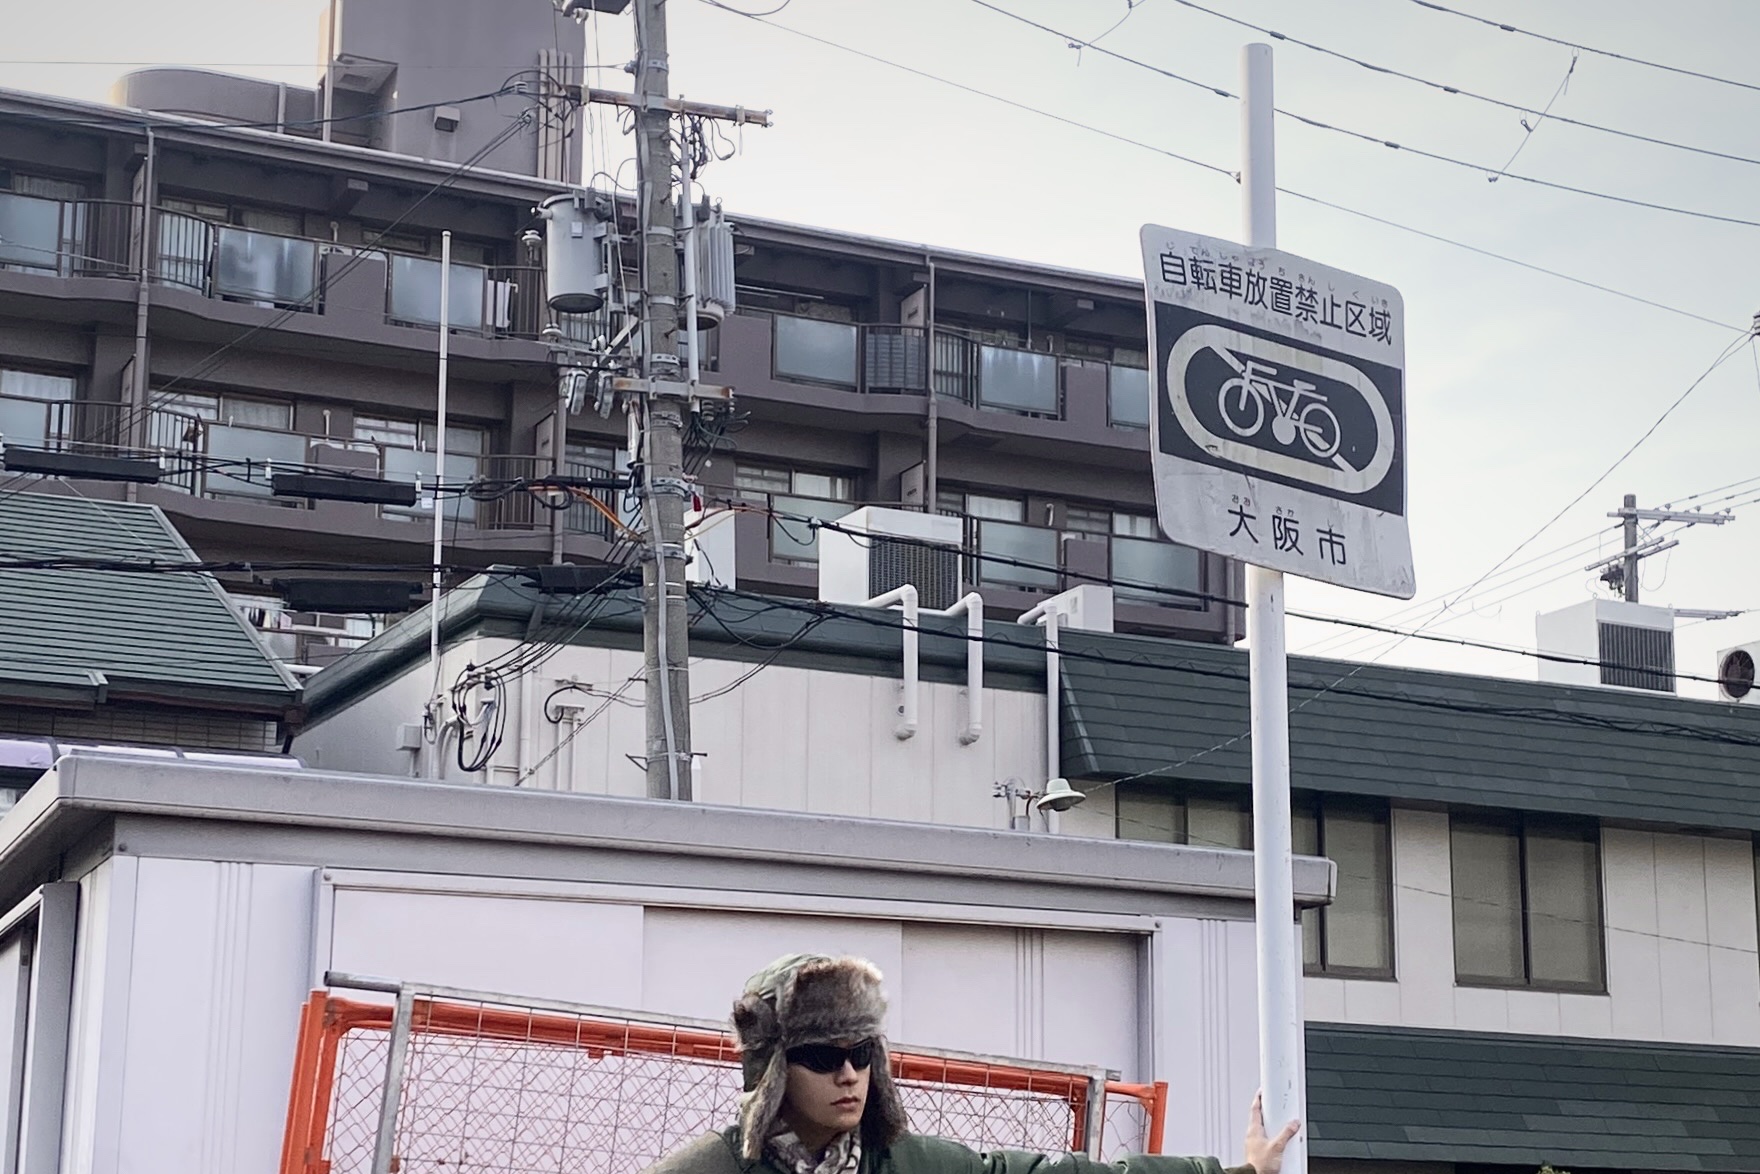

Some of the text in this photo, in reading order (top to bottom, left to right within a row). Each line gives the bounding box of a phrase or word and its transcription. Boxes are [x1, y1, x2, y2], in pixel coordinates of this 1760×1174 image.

[1160, 251, 1392, 346] 自転車放置禁止区域
[1227, 504, 1346, 566] 大阪市
